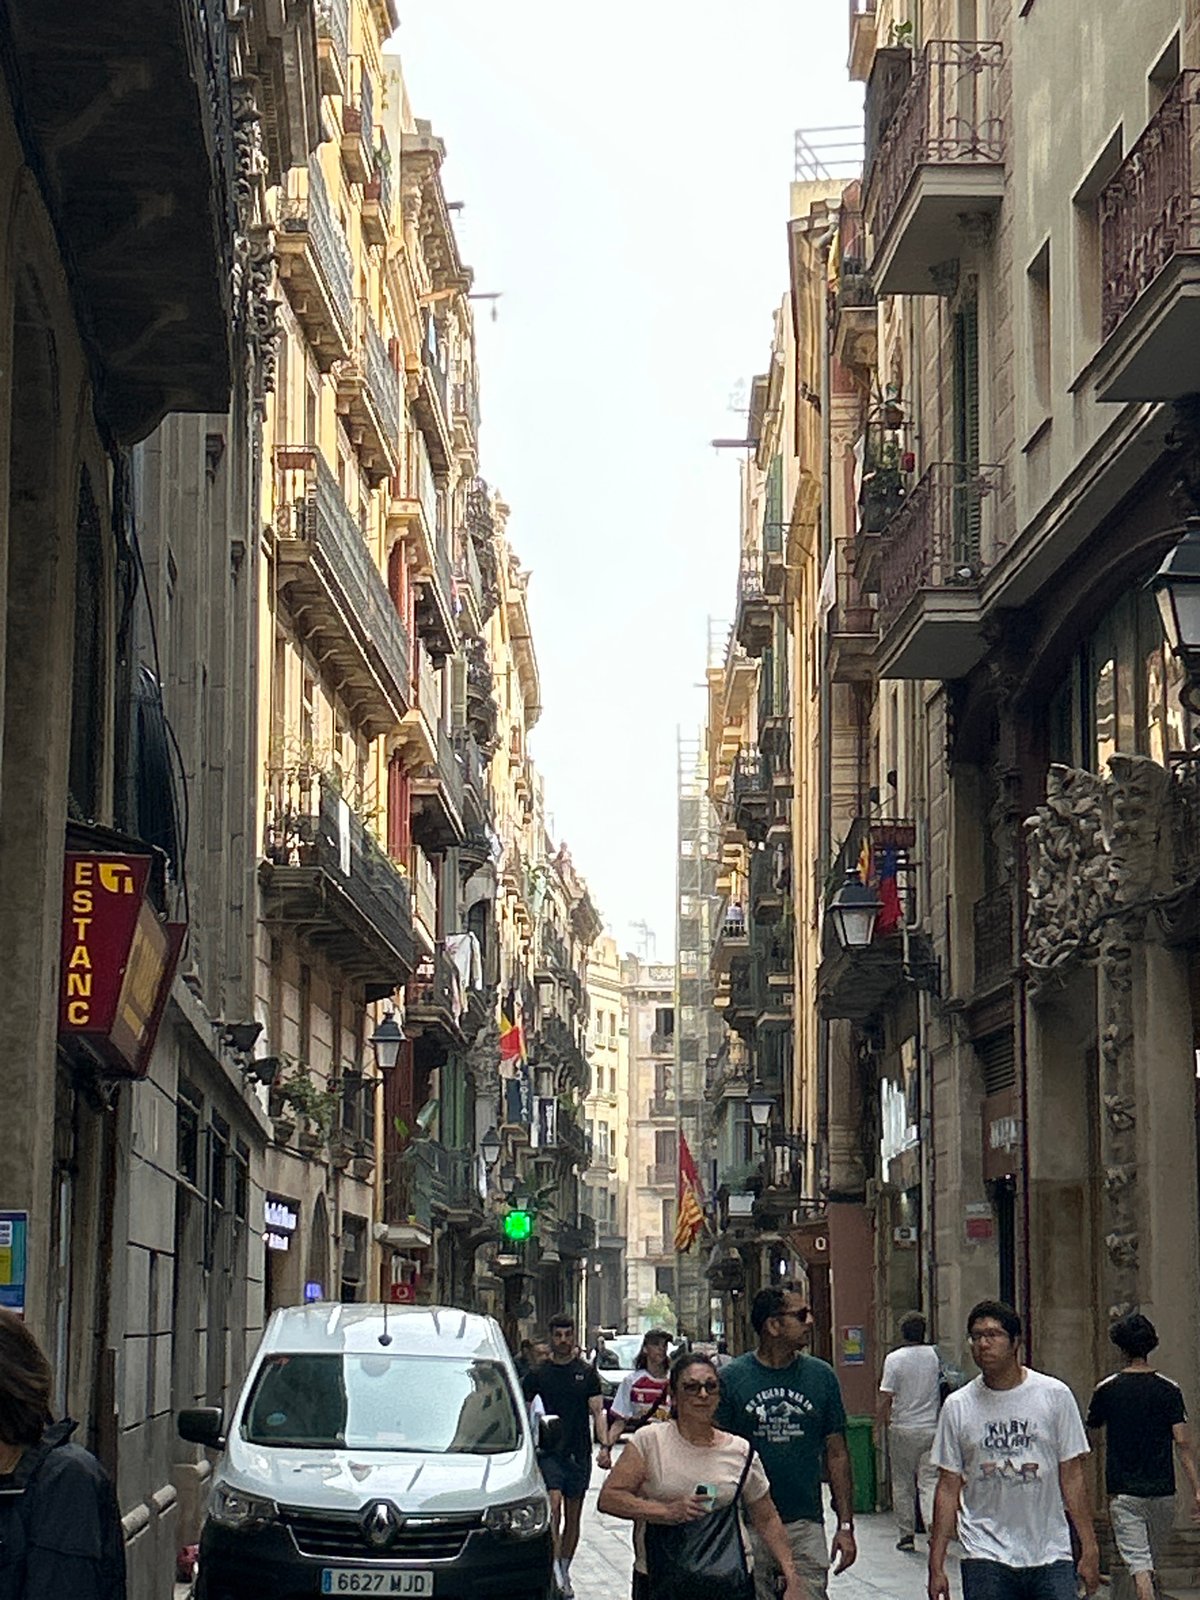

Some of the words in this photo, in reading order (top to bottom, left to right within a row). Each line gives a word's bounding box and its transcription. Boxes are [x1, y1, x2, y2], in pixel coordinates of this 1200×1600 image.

[67, 861, 93, 1025] ESTANC
[756, 1387, 785, 1402] FRIEND
[337, 1573, 385, 1591] 6627
[390, 1574, 425, 1593] MJD
